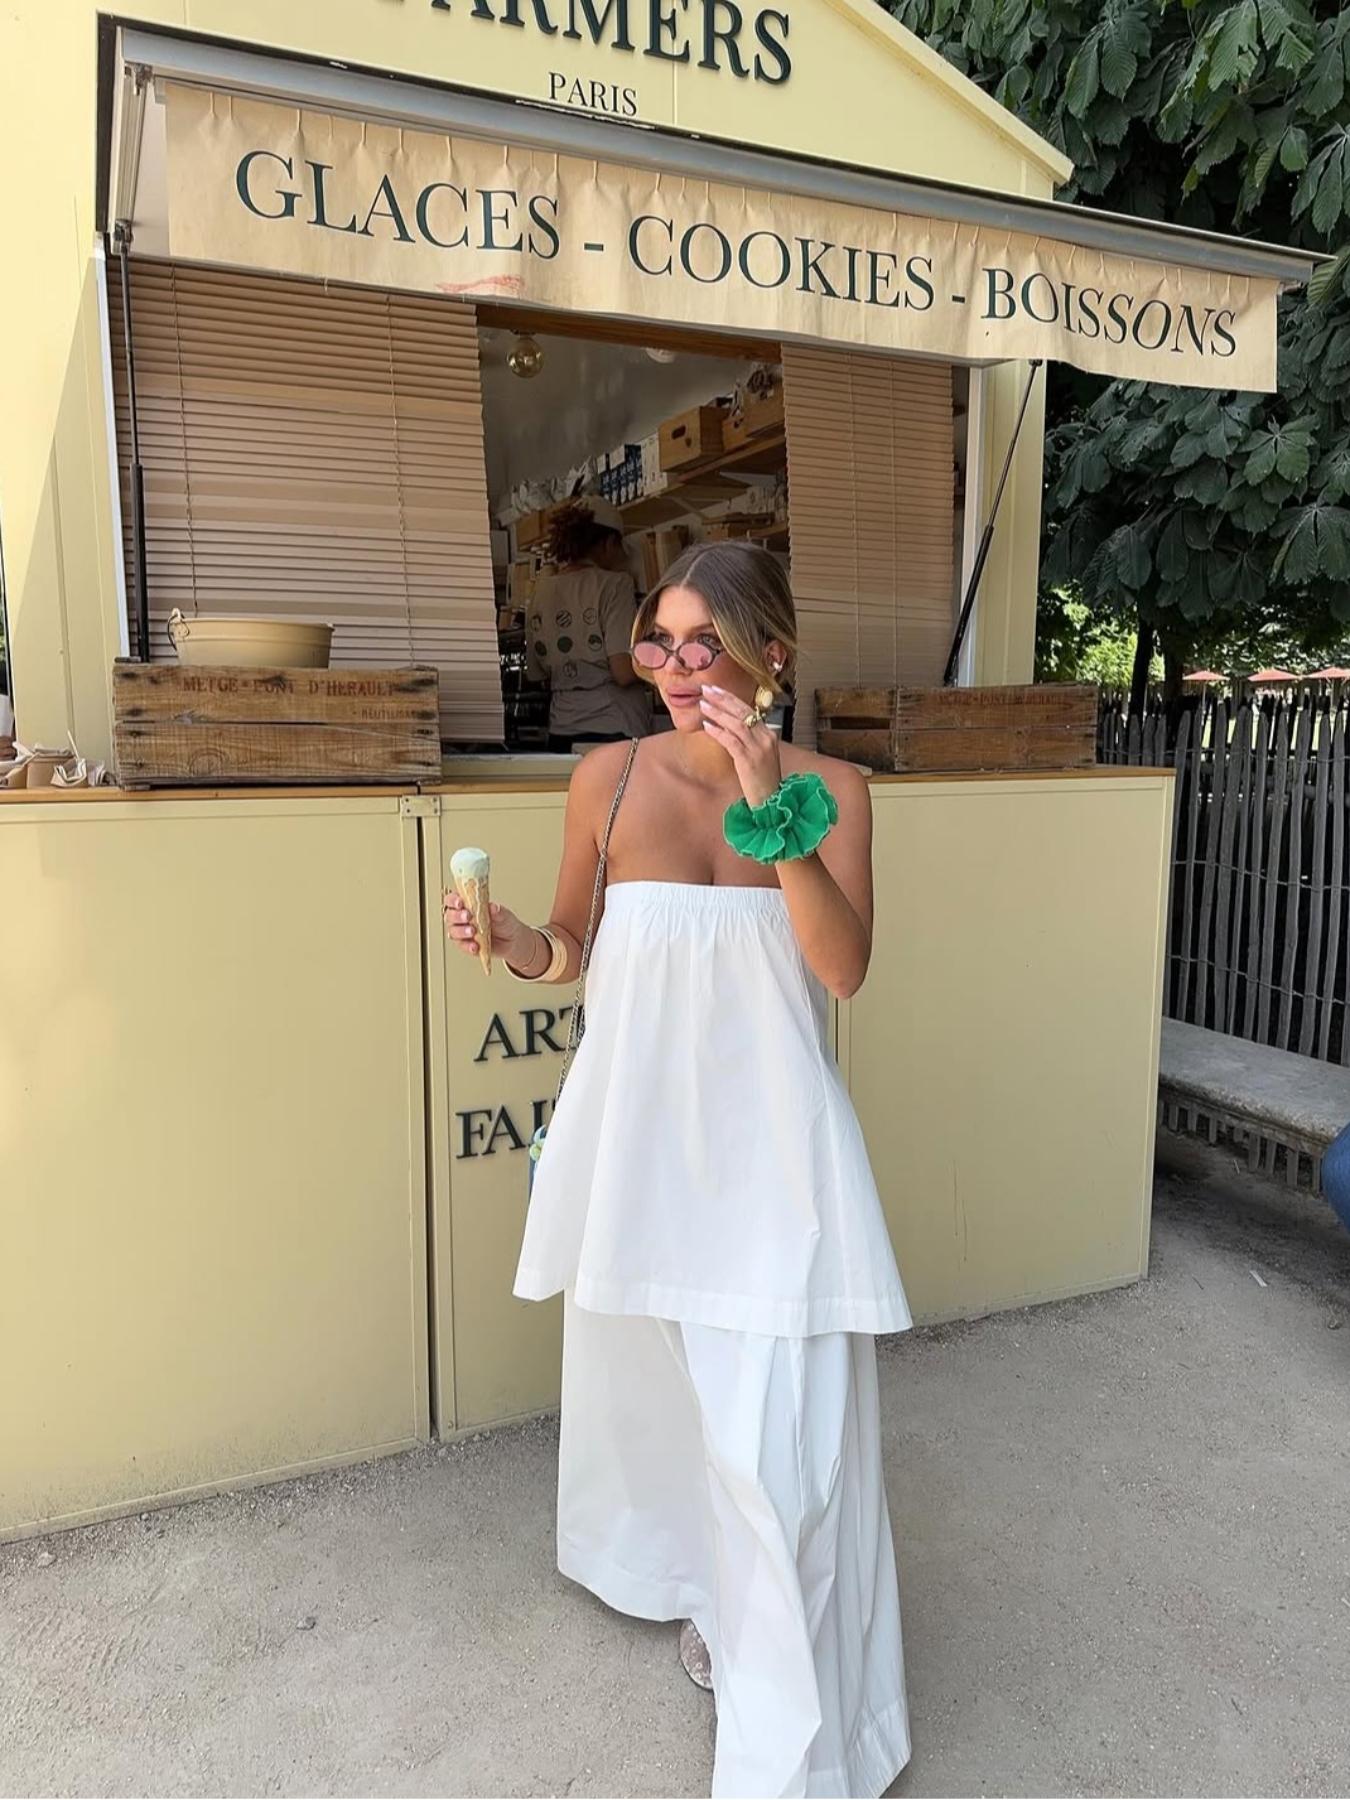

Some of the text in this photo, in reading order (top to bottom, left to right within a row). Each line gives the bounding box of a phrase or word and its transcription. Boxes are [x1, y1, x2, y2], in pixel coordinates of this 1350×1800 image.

[549, 72, 638, 117] PARIS
[236, 150, 560, 260] GLACES
[628, 215, 935, 311] COOKIES
[980, 267, 1236, 357] BOISSONS
